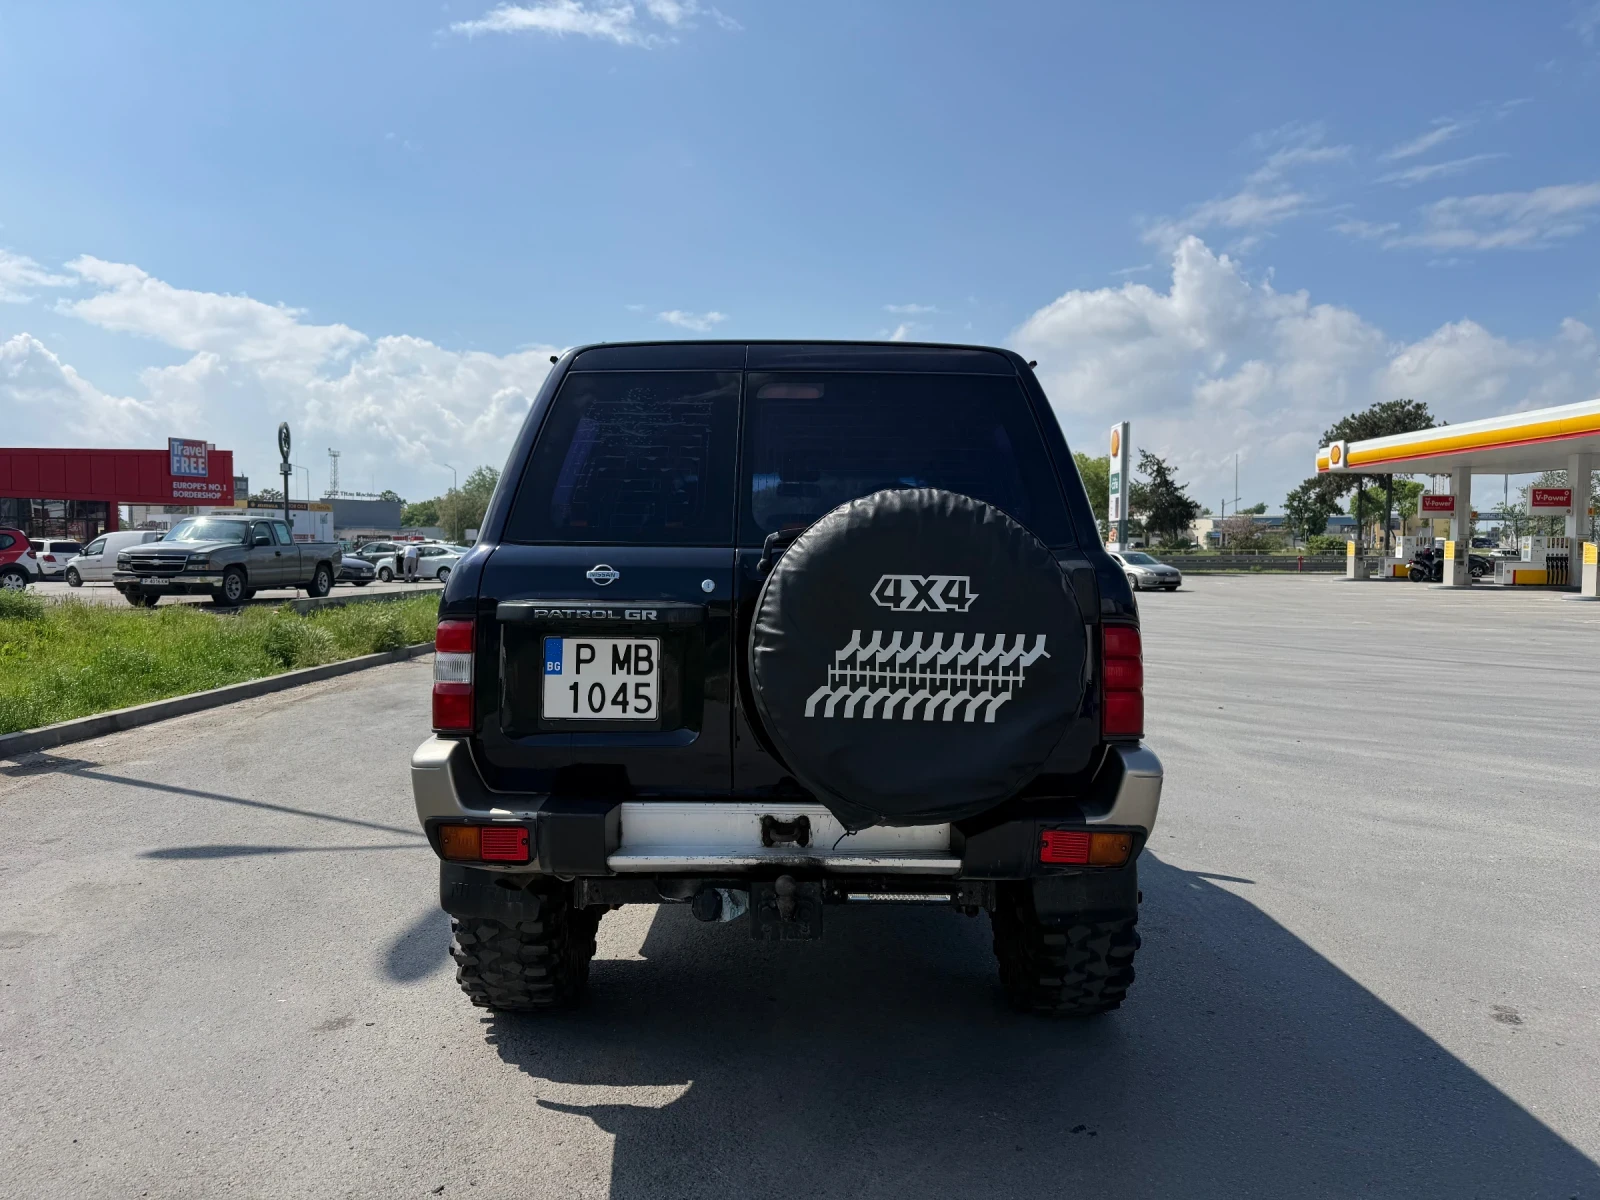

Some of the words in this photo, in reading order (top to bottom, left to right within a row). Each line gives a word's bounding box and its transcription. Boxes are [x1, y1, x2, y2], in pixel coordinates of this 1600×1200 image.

[172, 441, 205, 457] Travel
[173, 456, 206, 474] FREE
[173, 481, 207, 490] EUROPE'S
[173, 490, 221, 499] BORDERSHOP
[1536, 494, 1568, 502] V-Power
[588, 571, 617, 579] NISSAN
[534, 608, 621, 619] PATROL
[624, 609, 657, 620] GR
[575, 643, 596, 675] P
[611, 643, 654, 676] MB
[546, 661, 561, 671] BG
[569, 681, 652, 714] 1045
